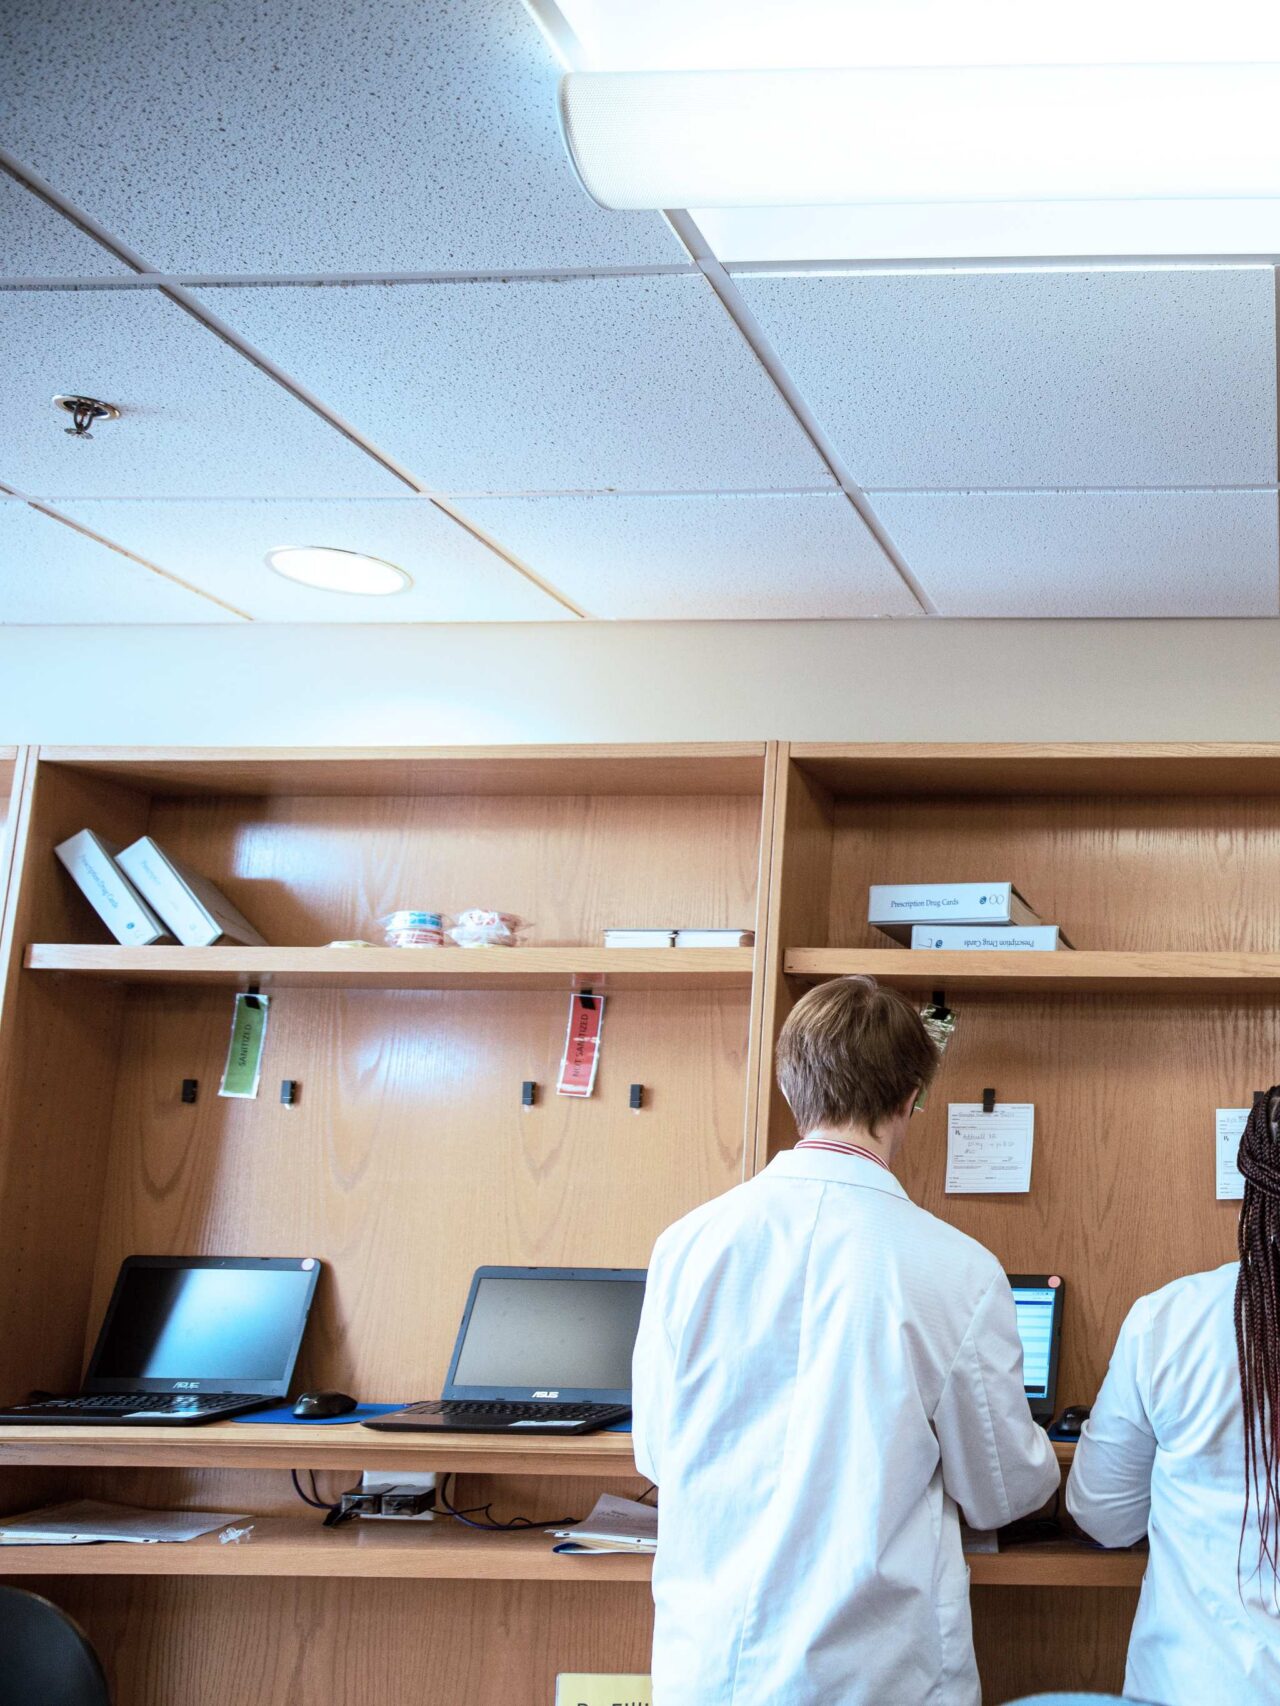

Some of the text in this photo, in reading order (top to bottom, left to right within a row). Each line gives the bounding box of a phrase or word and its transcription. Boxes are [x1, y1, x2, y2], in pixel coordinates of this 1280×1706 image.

[890, 898, 959, 910] Prescription Drug Cards
[964, 938, 1035, 948] Prescription Drug Cards
[239, 1024, 252, 1068] SANITIZED
[532, 1391, 560, 1399] ASUS
